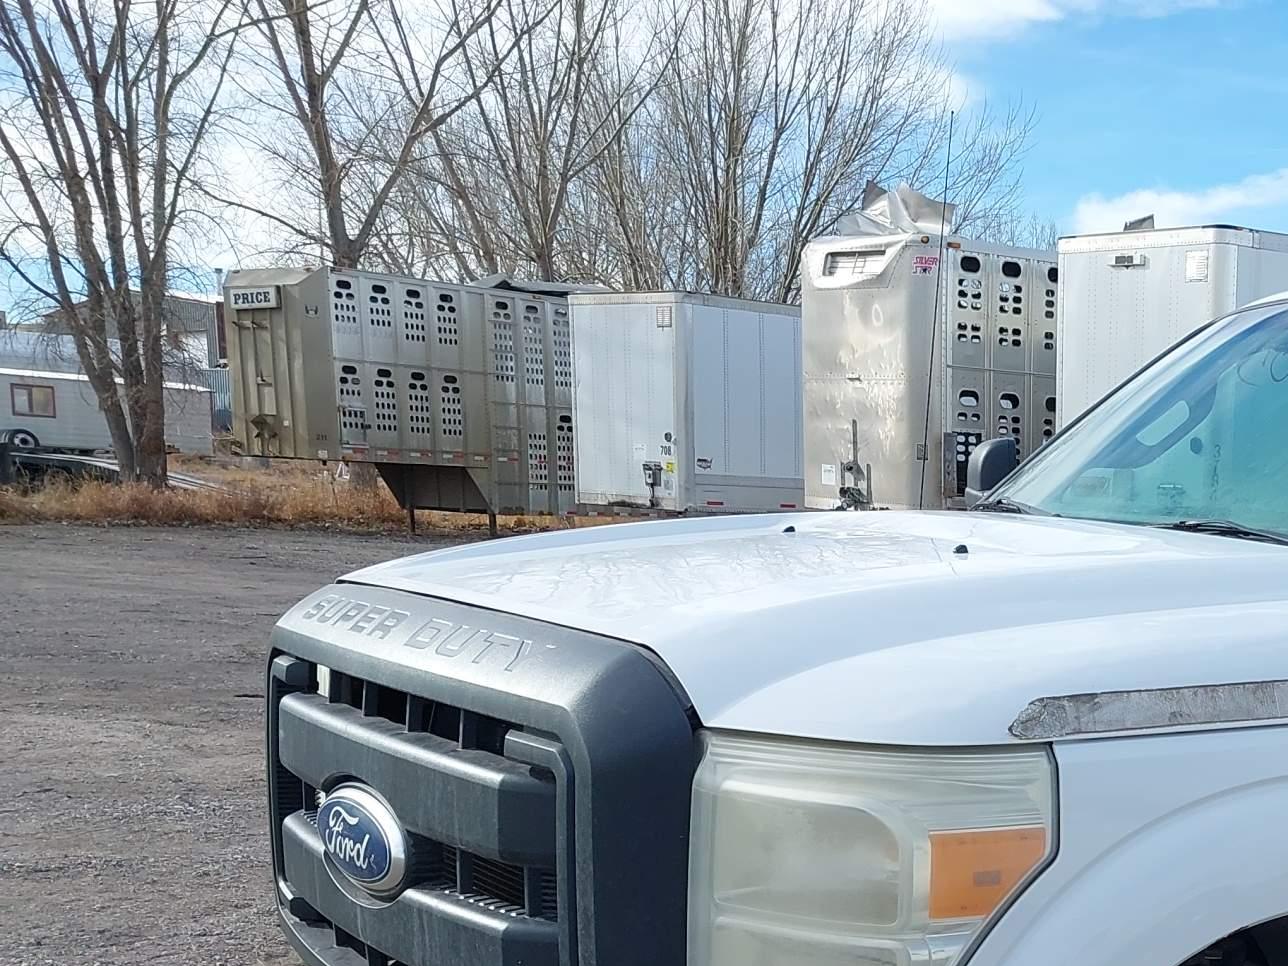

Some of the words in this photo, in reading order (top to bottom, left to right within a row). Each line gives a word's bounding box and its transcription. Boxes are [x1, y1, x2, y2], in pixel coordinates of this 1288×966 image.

[913, 256, 938, 266] SILVER
[233, 291, 271, 305] PRICE
[660, 445, 672, 456] 708
[302, 593, 412, 640] SUPER
[403, 618, 532, 673] DUTY
[325, 805, 370, 870] Ford
